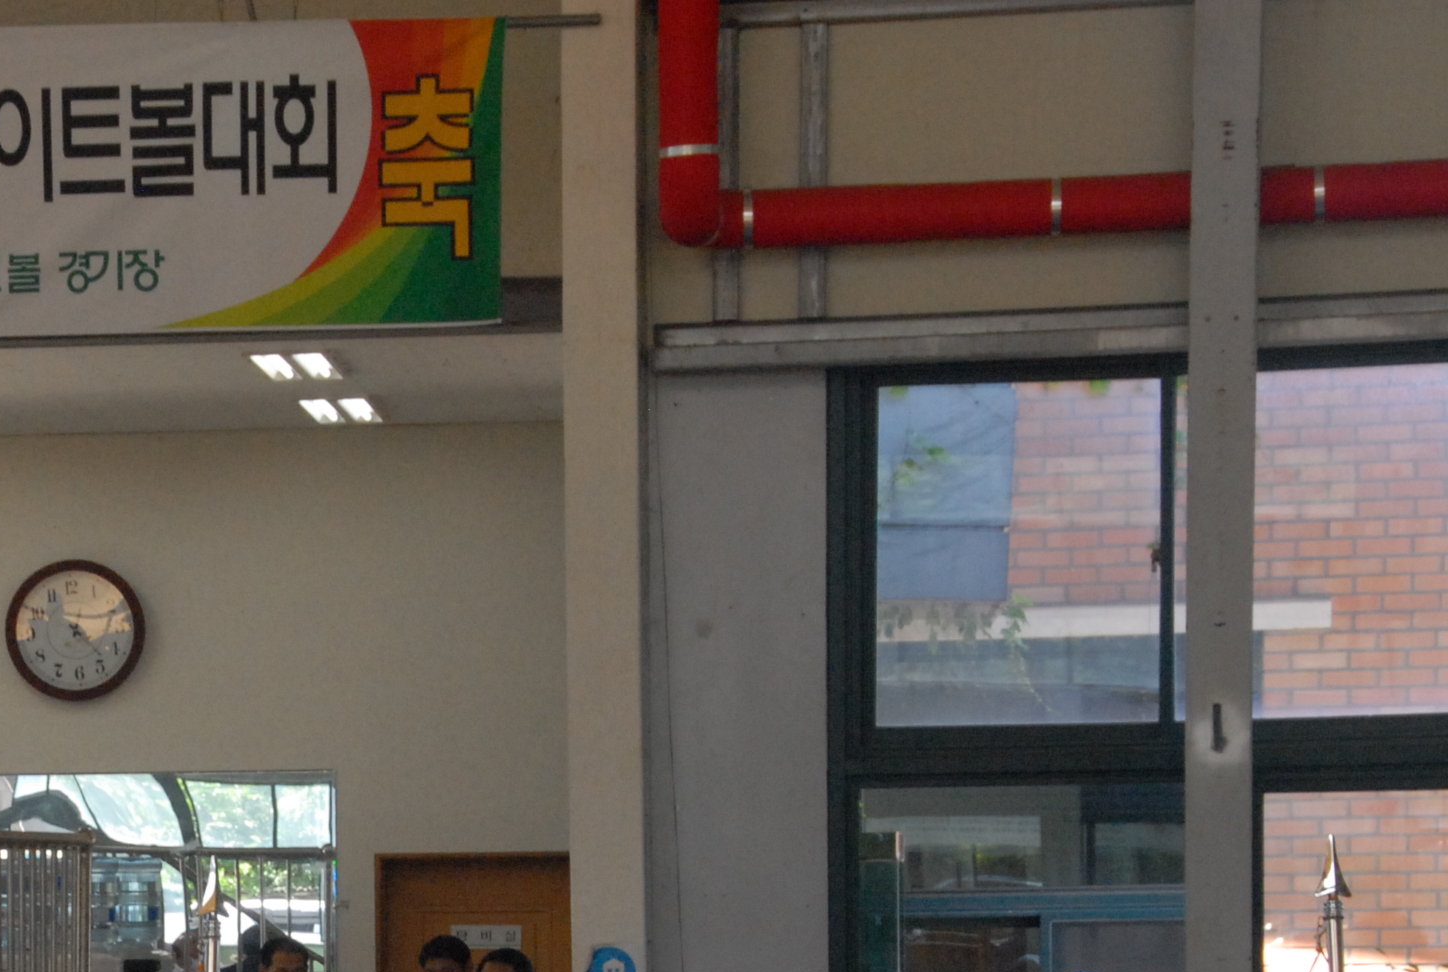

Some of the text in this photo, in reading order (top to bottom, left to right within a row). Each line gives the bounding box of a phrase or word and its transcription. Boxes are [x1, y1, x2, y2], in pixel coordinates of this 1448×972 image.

[378, 73, 475, 261] 축
[57, 249, 165, 293] 경기장
[74, 665, 85, 680] 6
